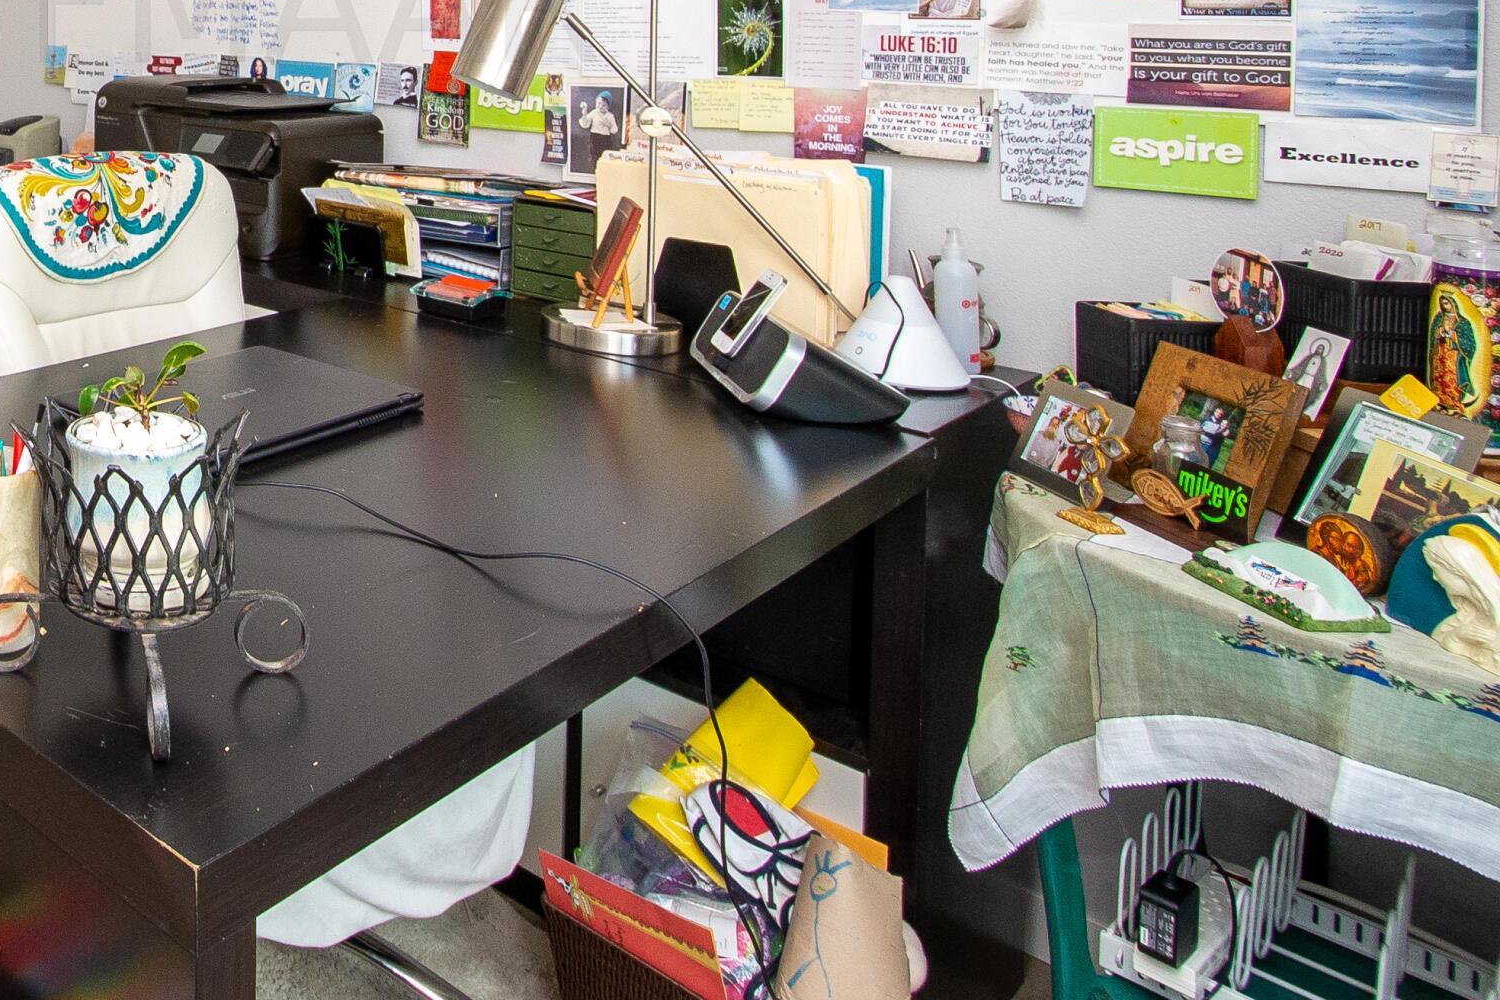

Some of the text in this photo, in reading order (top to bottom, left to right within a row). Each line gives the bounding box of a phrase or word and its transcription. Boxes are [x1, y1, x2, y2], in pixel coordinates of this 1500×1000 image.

[880, 35, 957, 54] LUKE 16:10
[988, 40, 1010, 48] Jesus
[1012, 41, 1040, 49] turned
[1134, 39, 1165, 48] What
[1168, 42, 1191, 50] you
[1216, 41, 1225, 50] is
[1228, 40, 1263, 51] God's
[1266, 41, 1288, 53] gift
[908, 55, 922, 63] CAN
[924, 56, 932, 64] BE
[935, 56, 966, 65] TRUSTED
[1027, 60, 1059, 68] healed
[1176, 54, 1206, 64] what
[1209, 57, 1233, 66] you
[1236, 55, 1287, 66] become
[865, 62, 970, 75] WITH VERY LITTLE CAN ALSO BE
[1039, 70, 1070, 78] healed
[872, 71, 963, 83] TRUSTED WITH MUCH, AND
[1026, 77, 1064, 85] Matthew
[1134, 68, 1287, 85] is your gift to God.
[279, 74, 329, 99] pray
[477, 87, 543, 114] begin
[427, 103, 464, 115] Kingdom
[822, 105, 843, 113] JOY
[880, 110, 937, 119] UNDERSTAND
[426, 113, 464, 131] GOD
[814, 114, 851, 123] COMES
[1003, 116, 1021, 129] for
[827, 124, 838, 132] IN
[822, 133, 842, 142] THE
[1109, 134, 1244, 167] aspire
[1279, 146, 1420, 169] Excellence
[1042, 163, 1067, 176] have
[1358, 219, 1382, 231] 2017
[1318, 246, 1344, 257] 2020
[1179, 470, 1247, 517] mikey's
